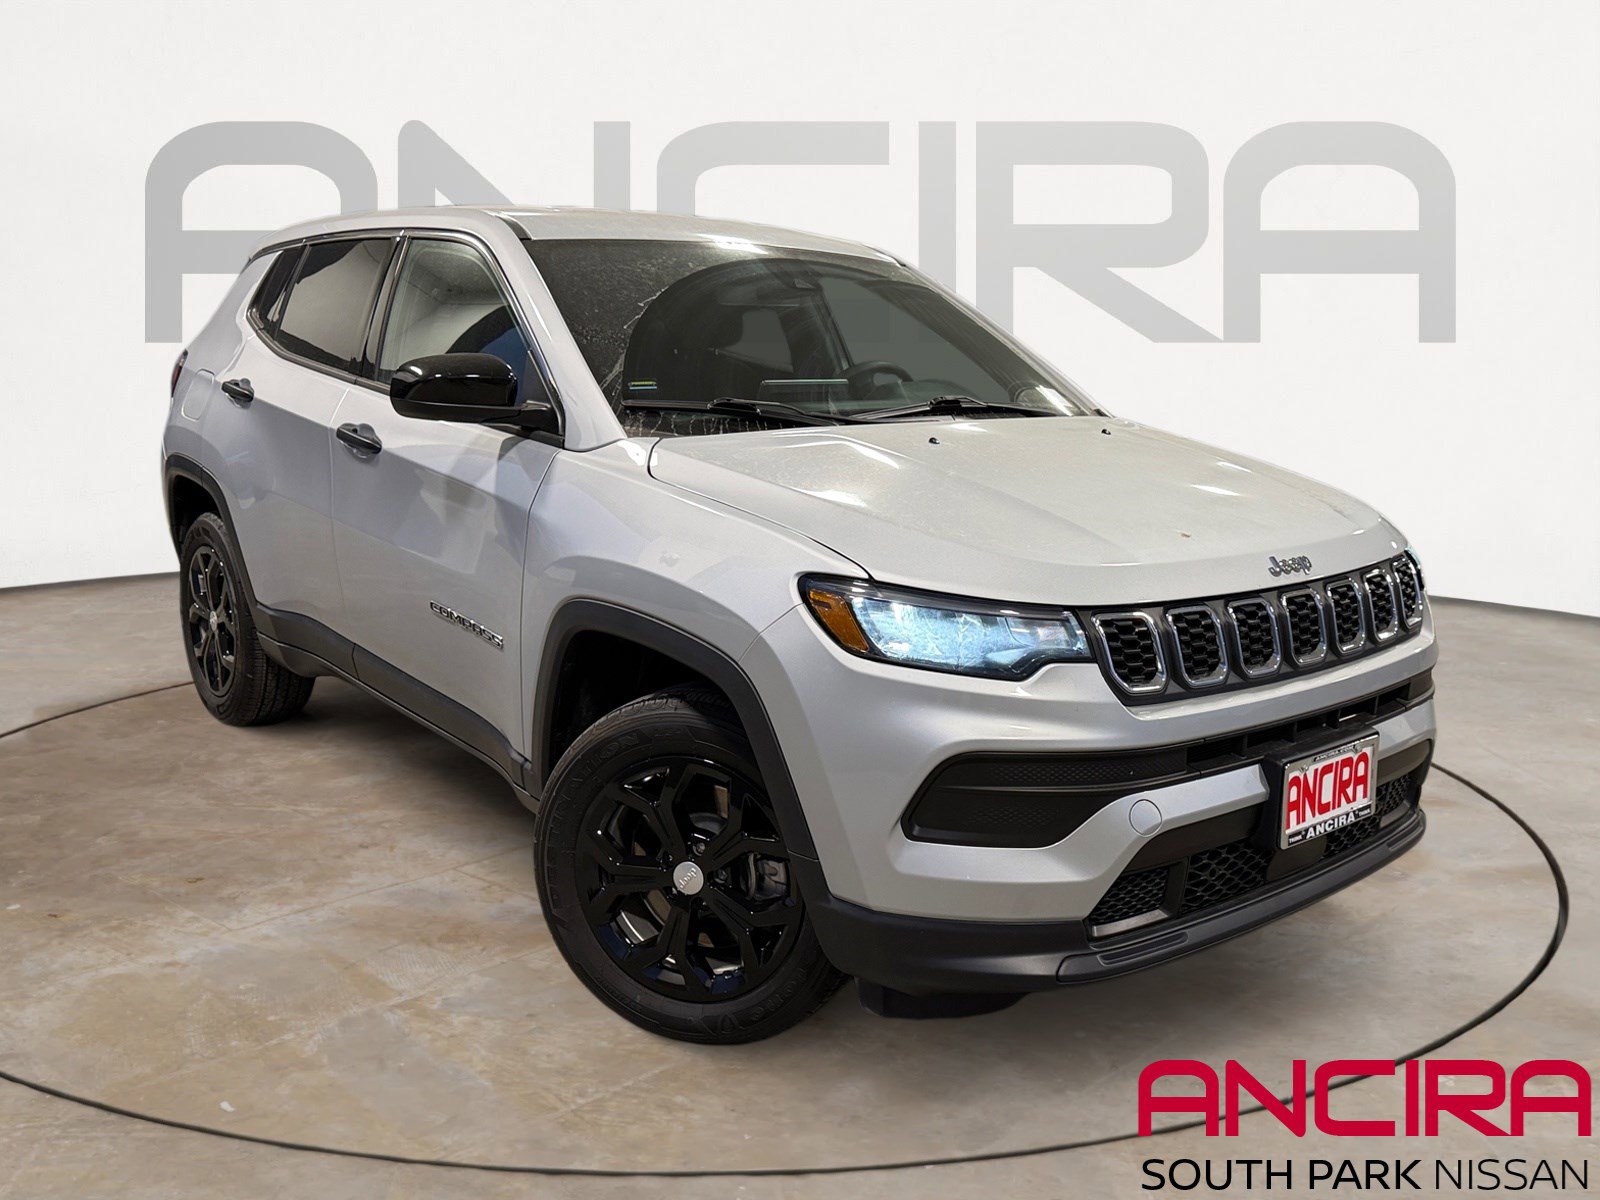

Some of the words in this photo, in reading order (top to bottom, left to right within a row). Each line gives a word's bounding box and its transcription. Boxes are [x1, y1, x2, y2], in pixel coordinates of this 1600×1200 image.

[1268, 555, 1312, 577] Jeep
[430, 600, 503, 648] COMPASS
[1285, 751, 1369, 830] ANCIRA
[1306, 811, 1355, 839] ANCIRA
